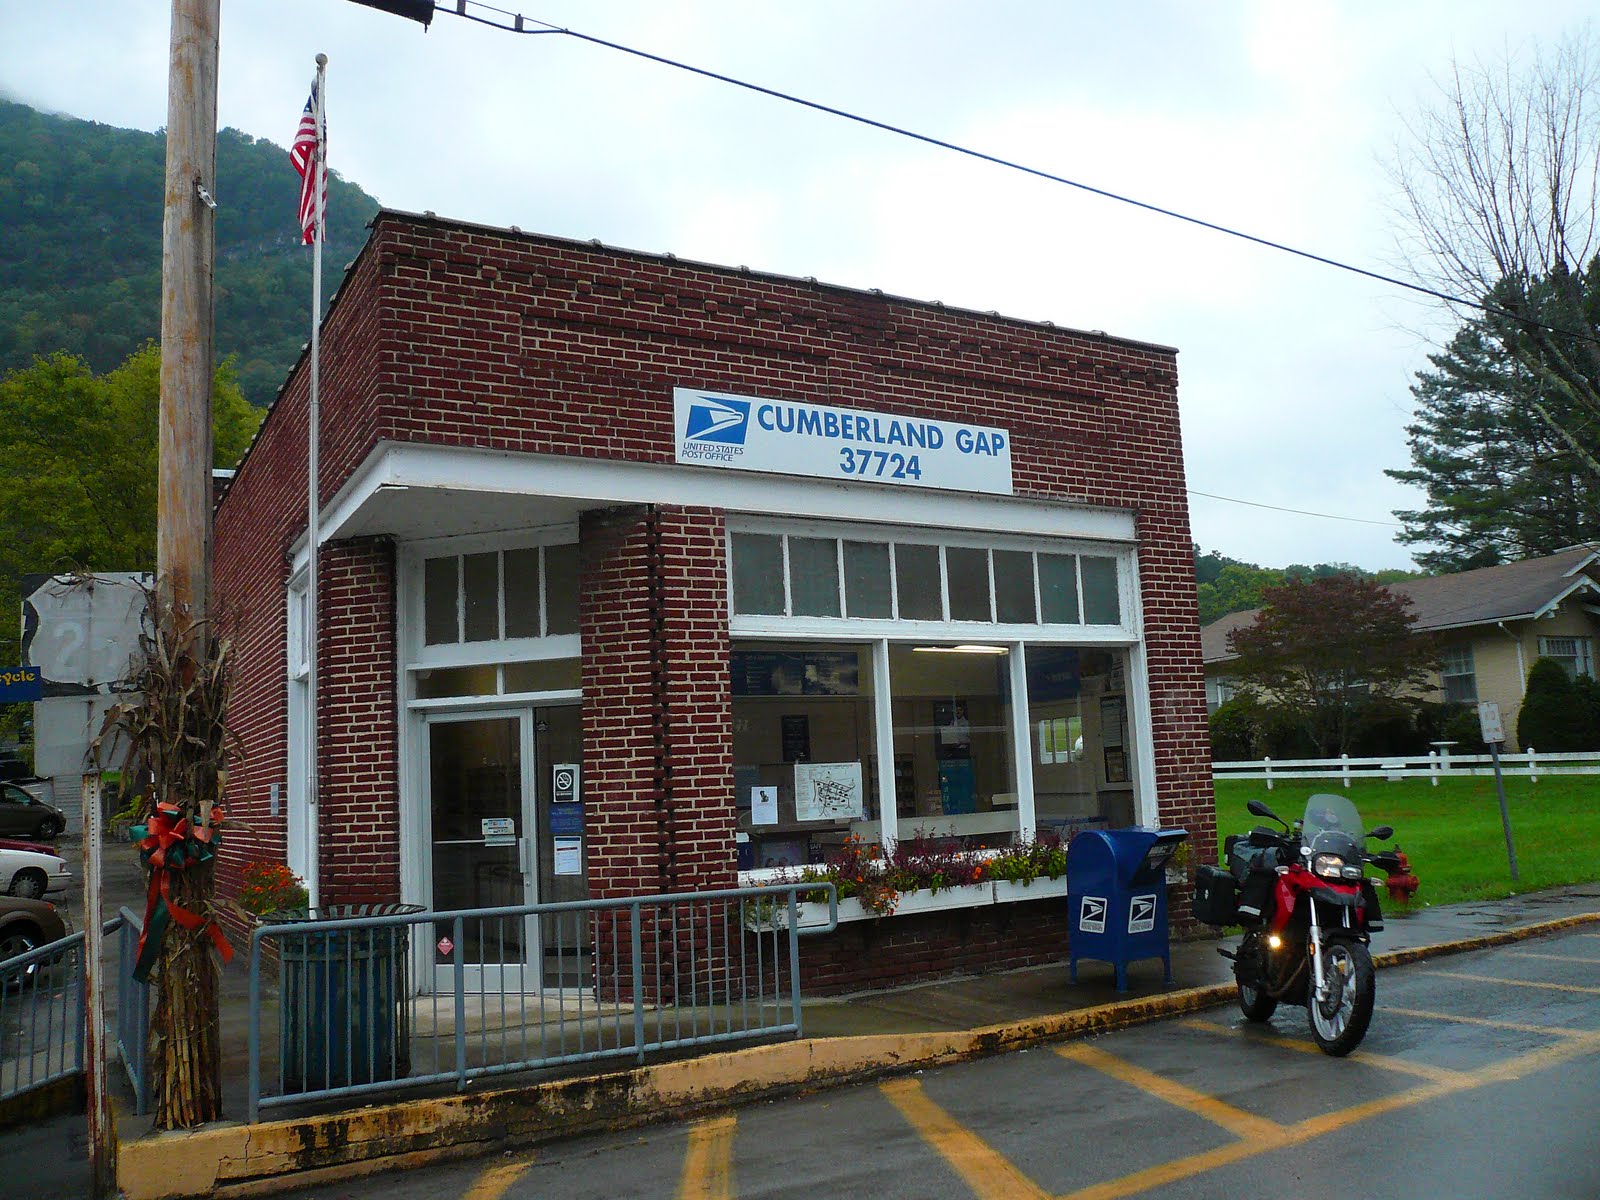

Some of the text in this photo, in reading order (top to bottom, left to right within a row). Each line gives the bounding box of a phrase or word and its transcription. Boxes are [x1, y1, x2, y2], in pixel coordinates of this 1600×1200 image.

[757, 404, 1005, 457] CUMBERLAND GAP
[681, 450, 734, 462] POST OFFICE
[683, 442, 745, 455] UNITED STATES
[839, 447, 922, 481] 37724
[0, 670, 36, 686] ycle
